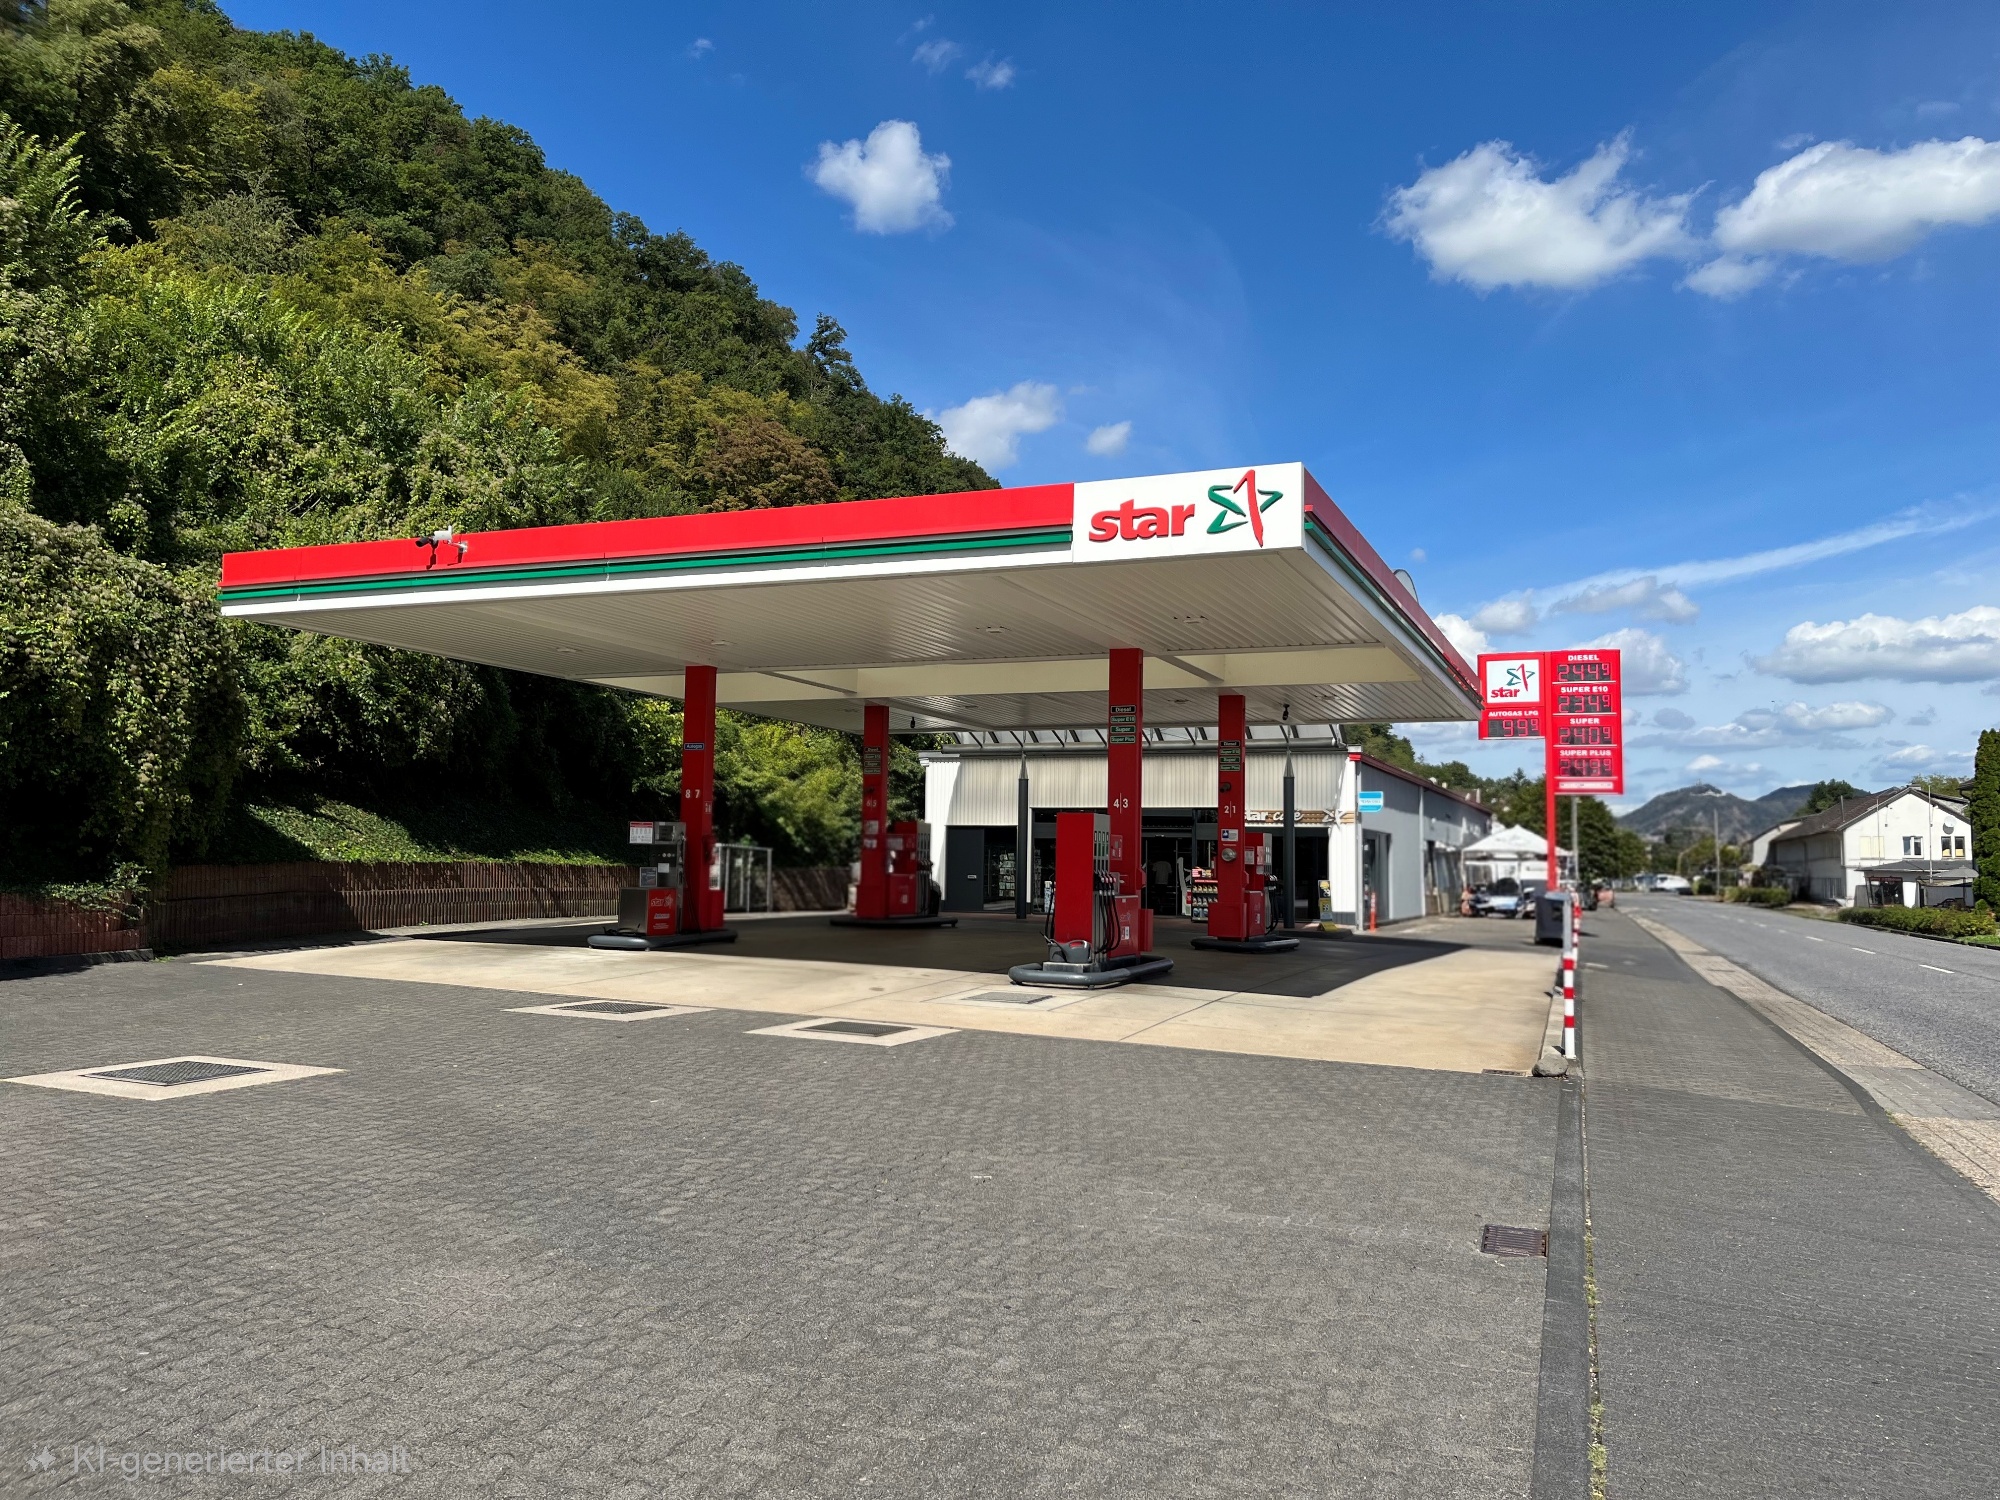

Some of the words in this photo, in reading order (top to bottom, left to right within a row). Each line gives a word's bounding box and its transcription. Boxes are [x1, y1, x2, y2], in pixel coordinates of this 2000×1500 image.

[1089, 499, 1195, 542] star
[1491, 687, 1520, 698] star
[685, 789, 691, 799] 8
[695, 789, 701, 799] 7
[1113, 799, 1119, 808] 4
[1122, 799, 1128, 808] 3
[1224, 806, 1230, 814] 2
[1232, 806, 1237, 814] 1
[1244, 807, 1268, 821] tar
